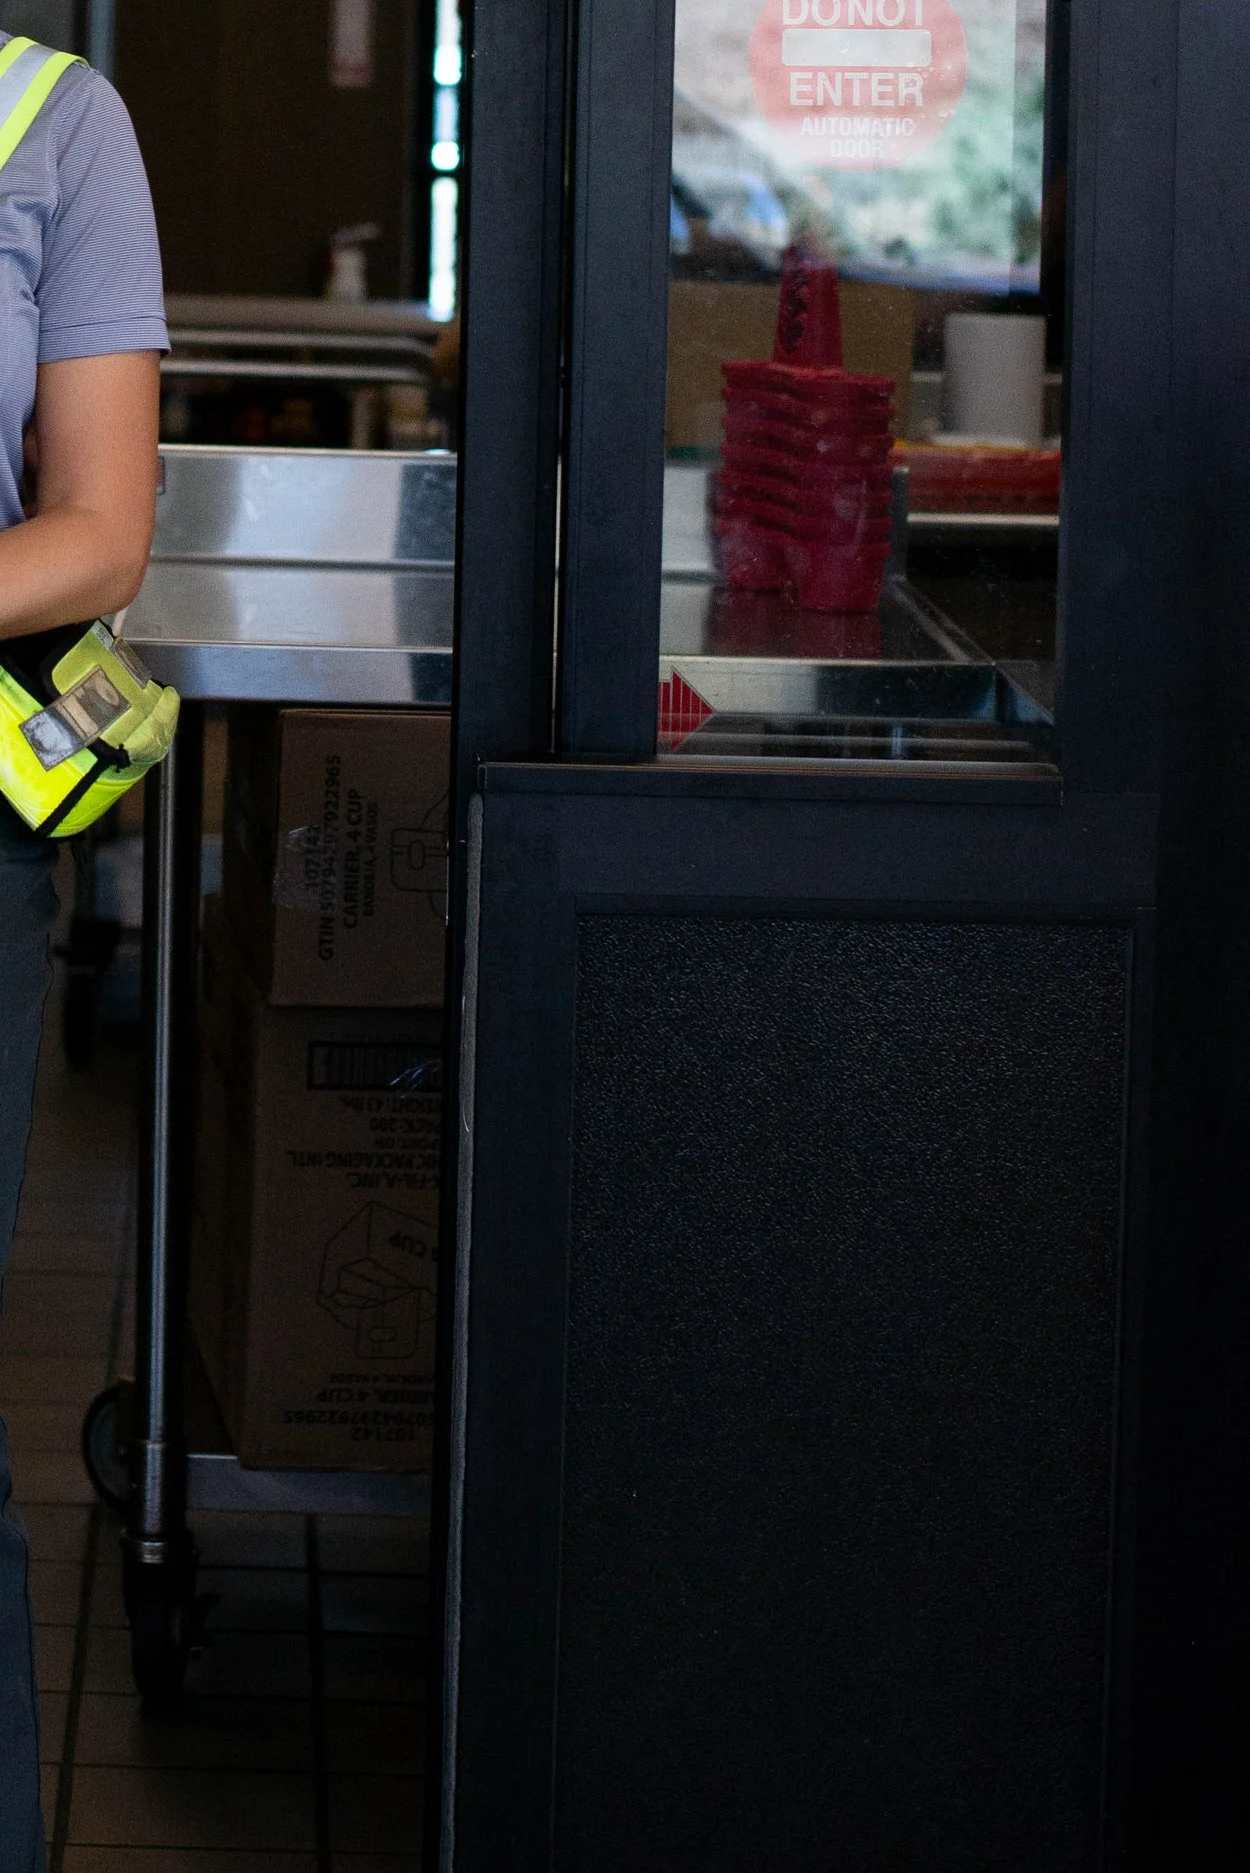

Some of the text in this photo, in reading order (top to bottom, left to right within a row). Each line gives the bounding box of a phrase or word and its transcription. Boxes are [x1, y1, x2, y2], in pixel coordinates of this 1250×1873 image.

[790, 72, 924, 107] ENTER
[799, 116, 914, 138] AUTOMATIC
[830, 137, 884, 159] DOOR
[366, 801, 377, 843] VASOS
[344, 788, 364, 930] CARRIER, 4 CUP
[319, 916, 334, 961] GTIN
[388, 1231, 427, 1258] CUP
[316, 1388, 353, 1402] CUP
